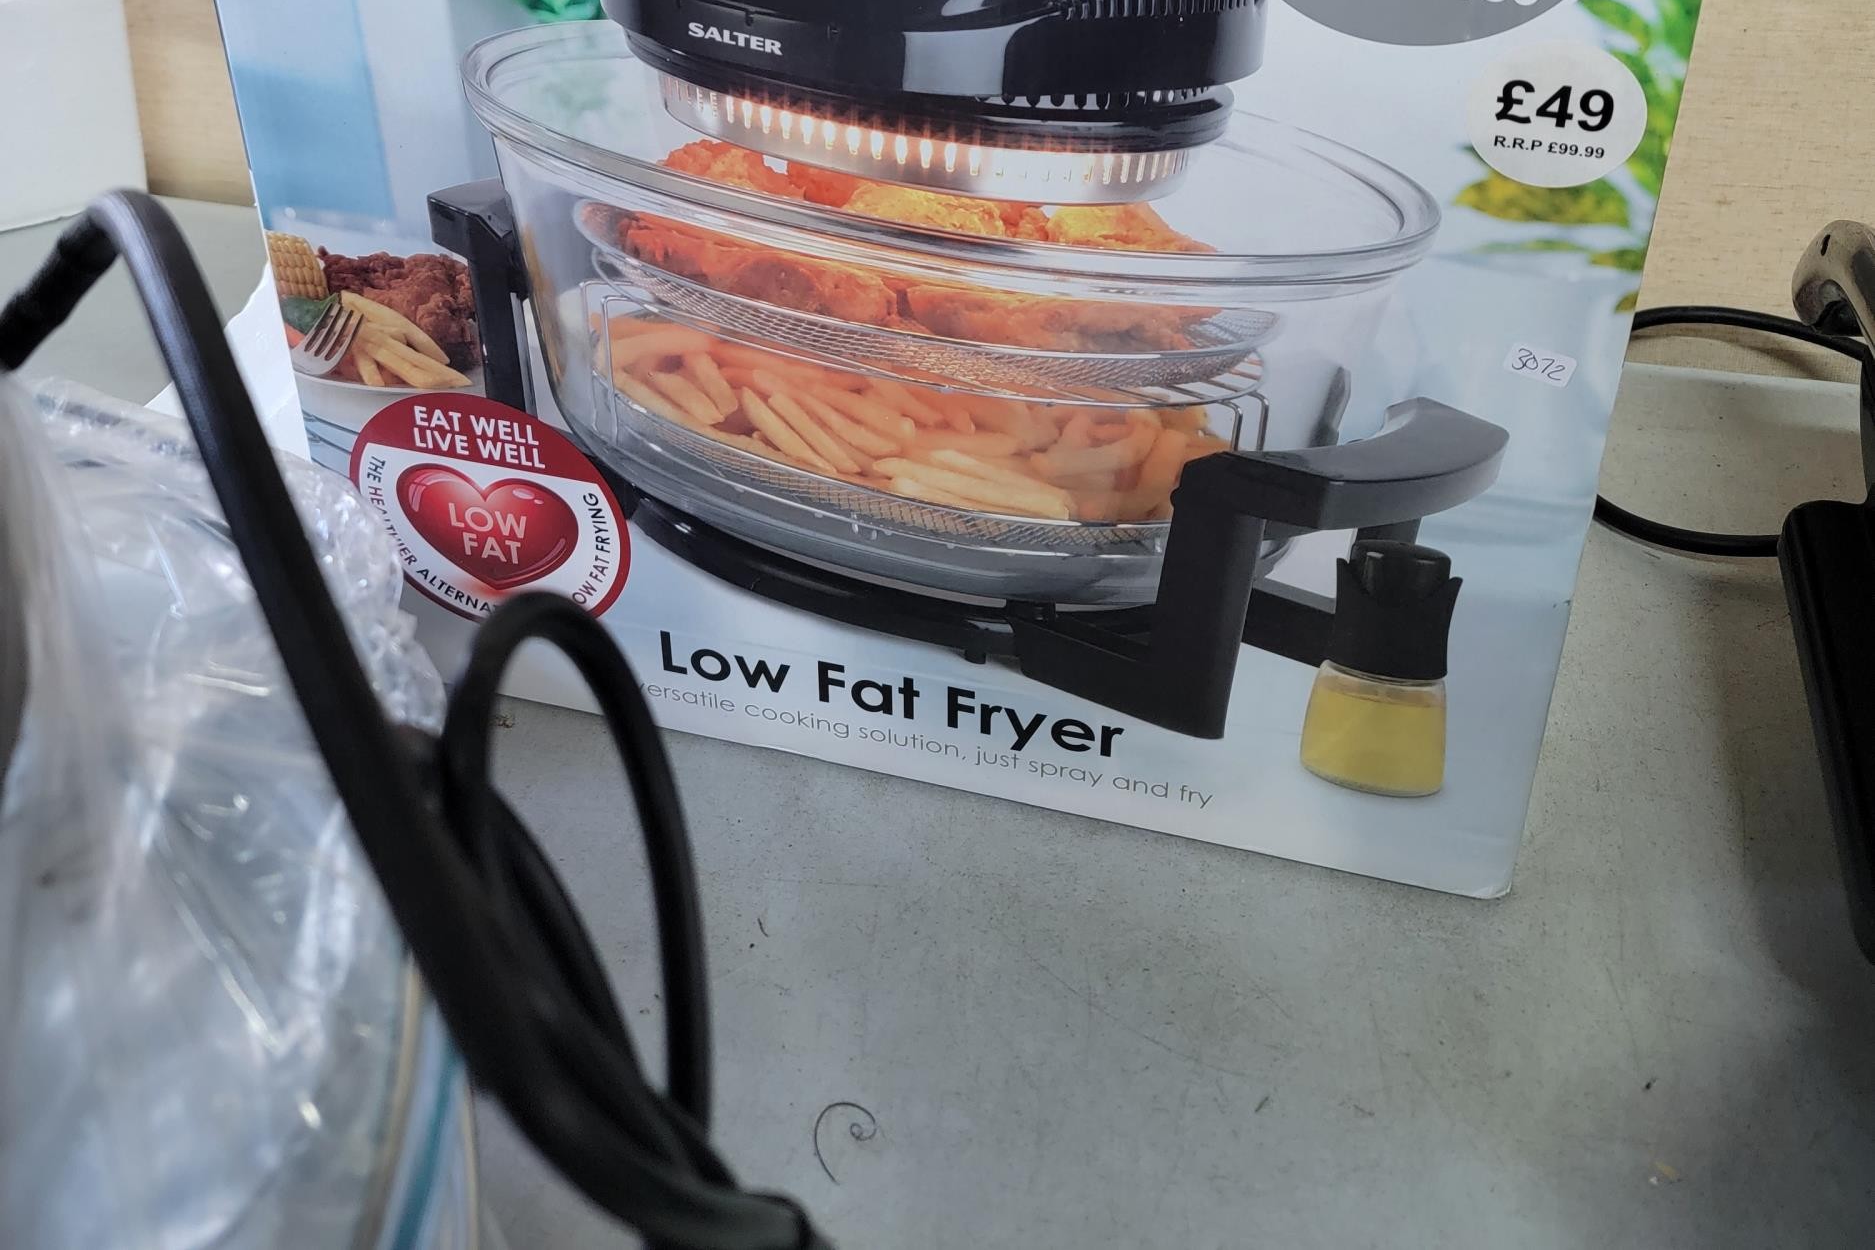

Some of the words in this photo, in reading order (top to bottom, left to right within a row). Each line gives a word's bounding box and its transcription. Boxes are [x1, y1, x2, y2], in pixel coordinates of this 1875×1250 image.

[688, 22, 783, 56] SALTER
[1495, 79, 1615, 132] £49
[1494, 135, 1543, 151] R.R.P
[1548, 142, 1605, 159] £99.99
[414, 405, 462, 430] EAT
[469, 415, 539, 446] WELL
[414, 427, 469, 455] LIVE
[476, 439, 545, 469] WELL
[367, 456, 386, 483] THE
[448, 503, 527, 538] LOW
[583, 493, 610, 553] FRYING
[462, 532, 521, 565] FAT
[589, 555, 610, 583] FAT
[572, 580, 597, 605] OW
[659, 630, 791, 694] Low
[817, 659, 921, 719] Fat
[946, 687, 1125, 758] Fryer
[744, 704, 850, 739] cooking
[859, 725, 967, 760] solution,
[975, 746, 1020, 769] just
[1028, 759, 1104, 787] spray
[1112, 776, 1169, 799] and
[1180, 785, 1213, 809] fry
